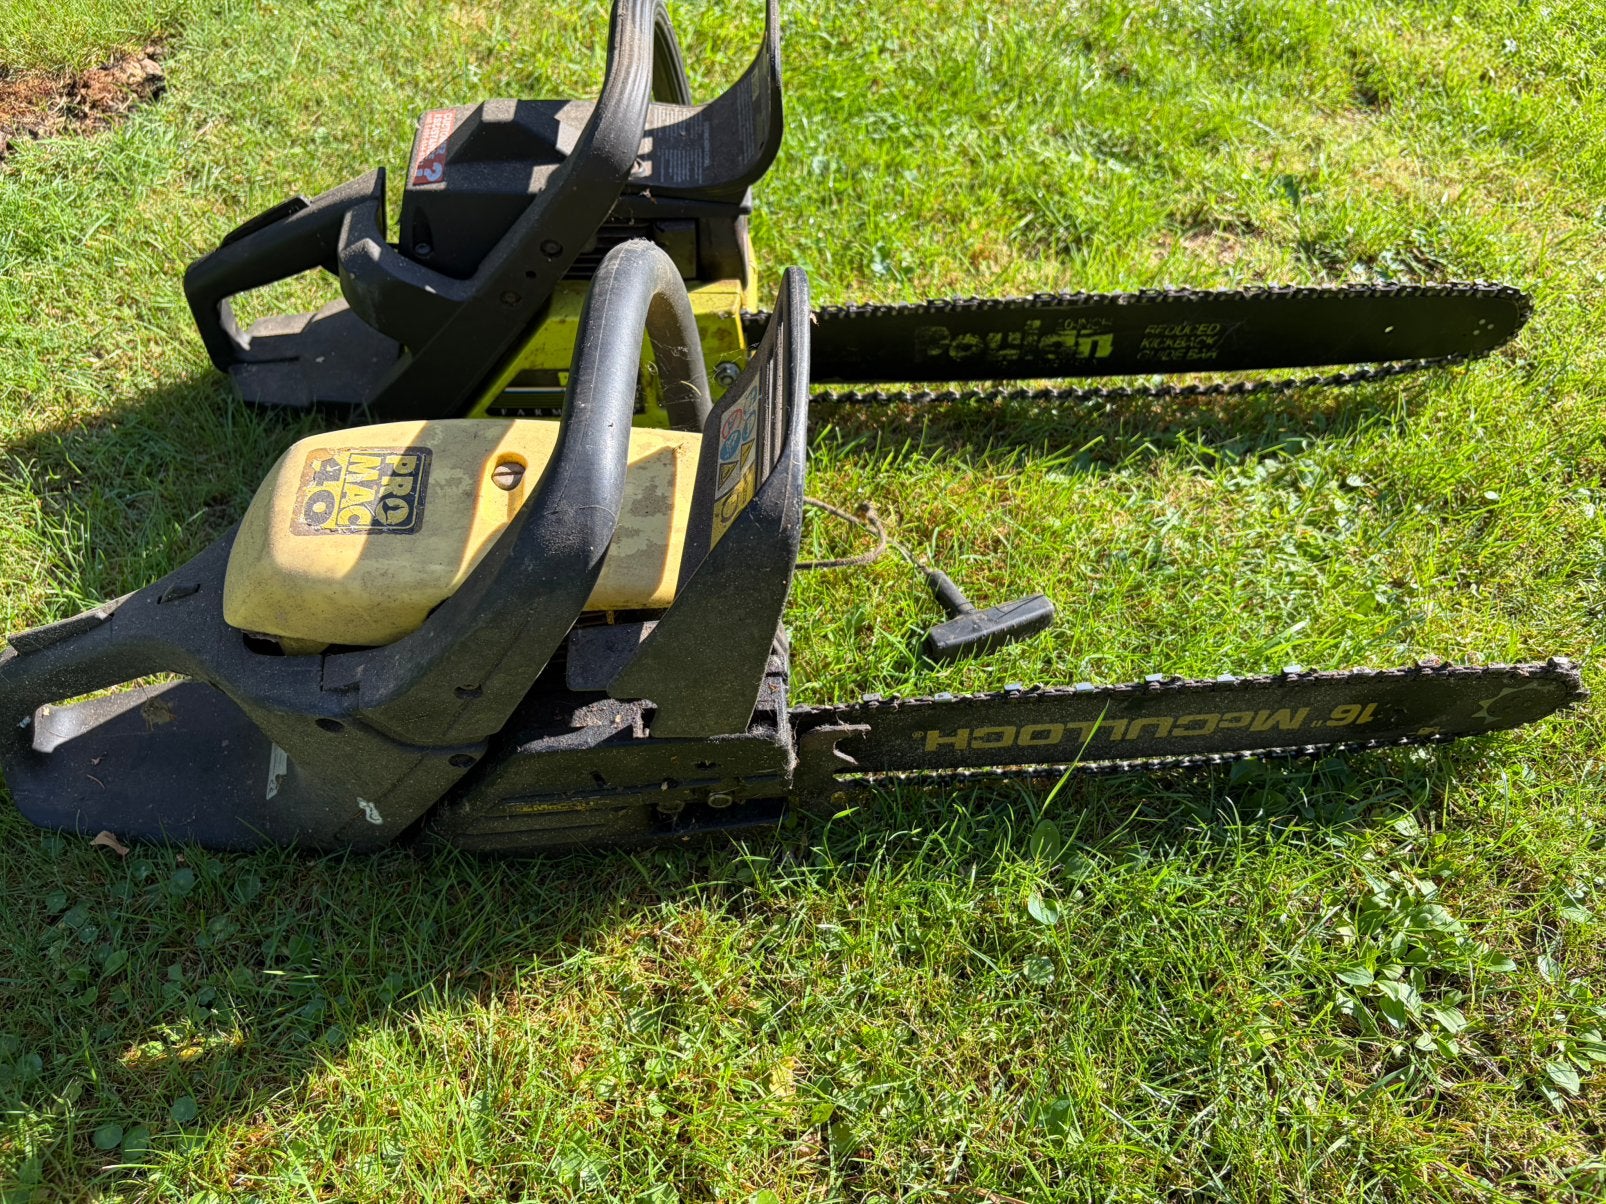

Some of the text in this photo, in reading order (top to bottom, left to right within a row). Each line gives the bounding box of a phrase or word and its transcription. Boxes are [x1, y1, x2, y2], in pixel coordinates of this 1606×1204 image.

[915, 319, 1114, 362] Poulan
[303, 457, 343, 527] 40
[337, 454, 382, 526] MAC
[375, 455, 418, 526] PRO
